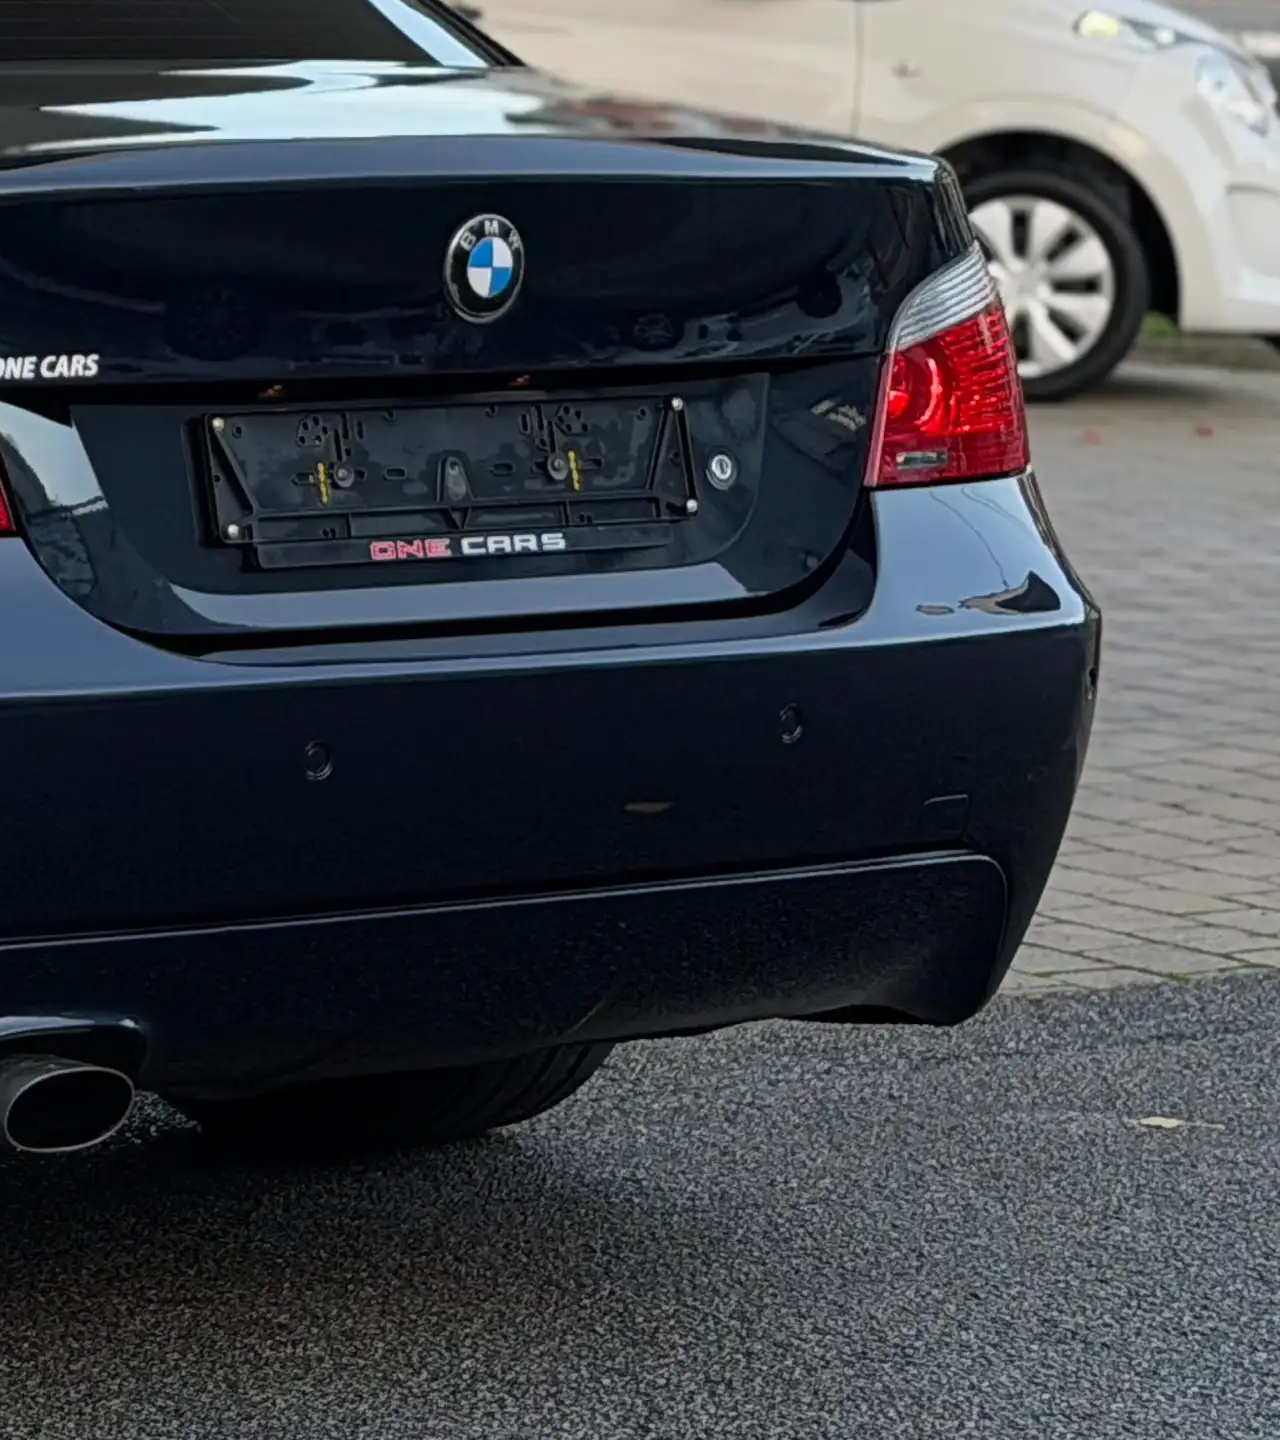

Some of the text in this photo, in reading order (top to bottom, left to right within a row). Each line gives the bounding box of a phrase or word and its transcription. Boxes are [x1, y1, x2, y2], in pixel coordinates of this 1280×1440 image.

[460, 219, 521, 251] BMW
[40, 353, 99, 378] CARS
[370, 532, 566, 560] ONE CARS
